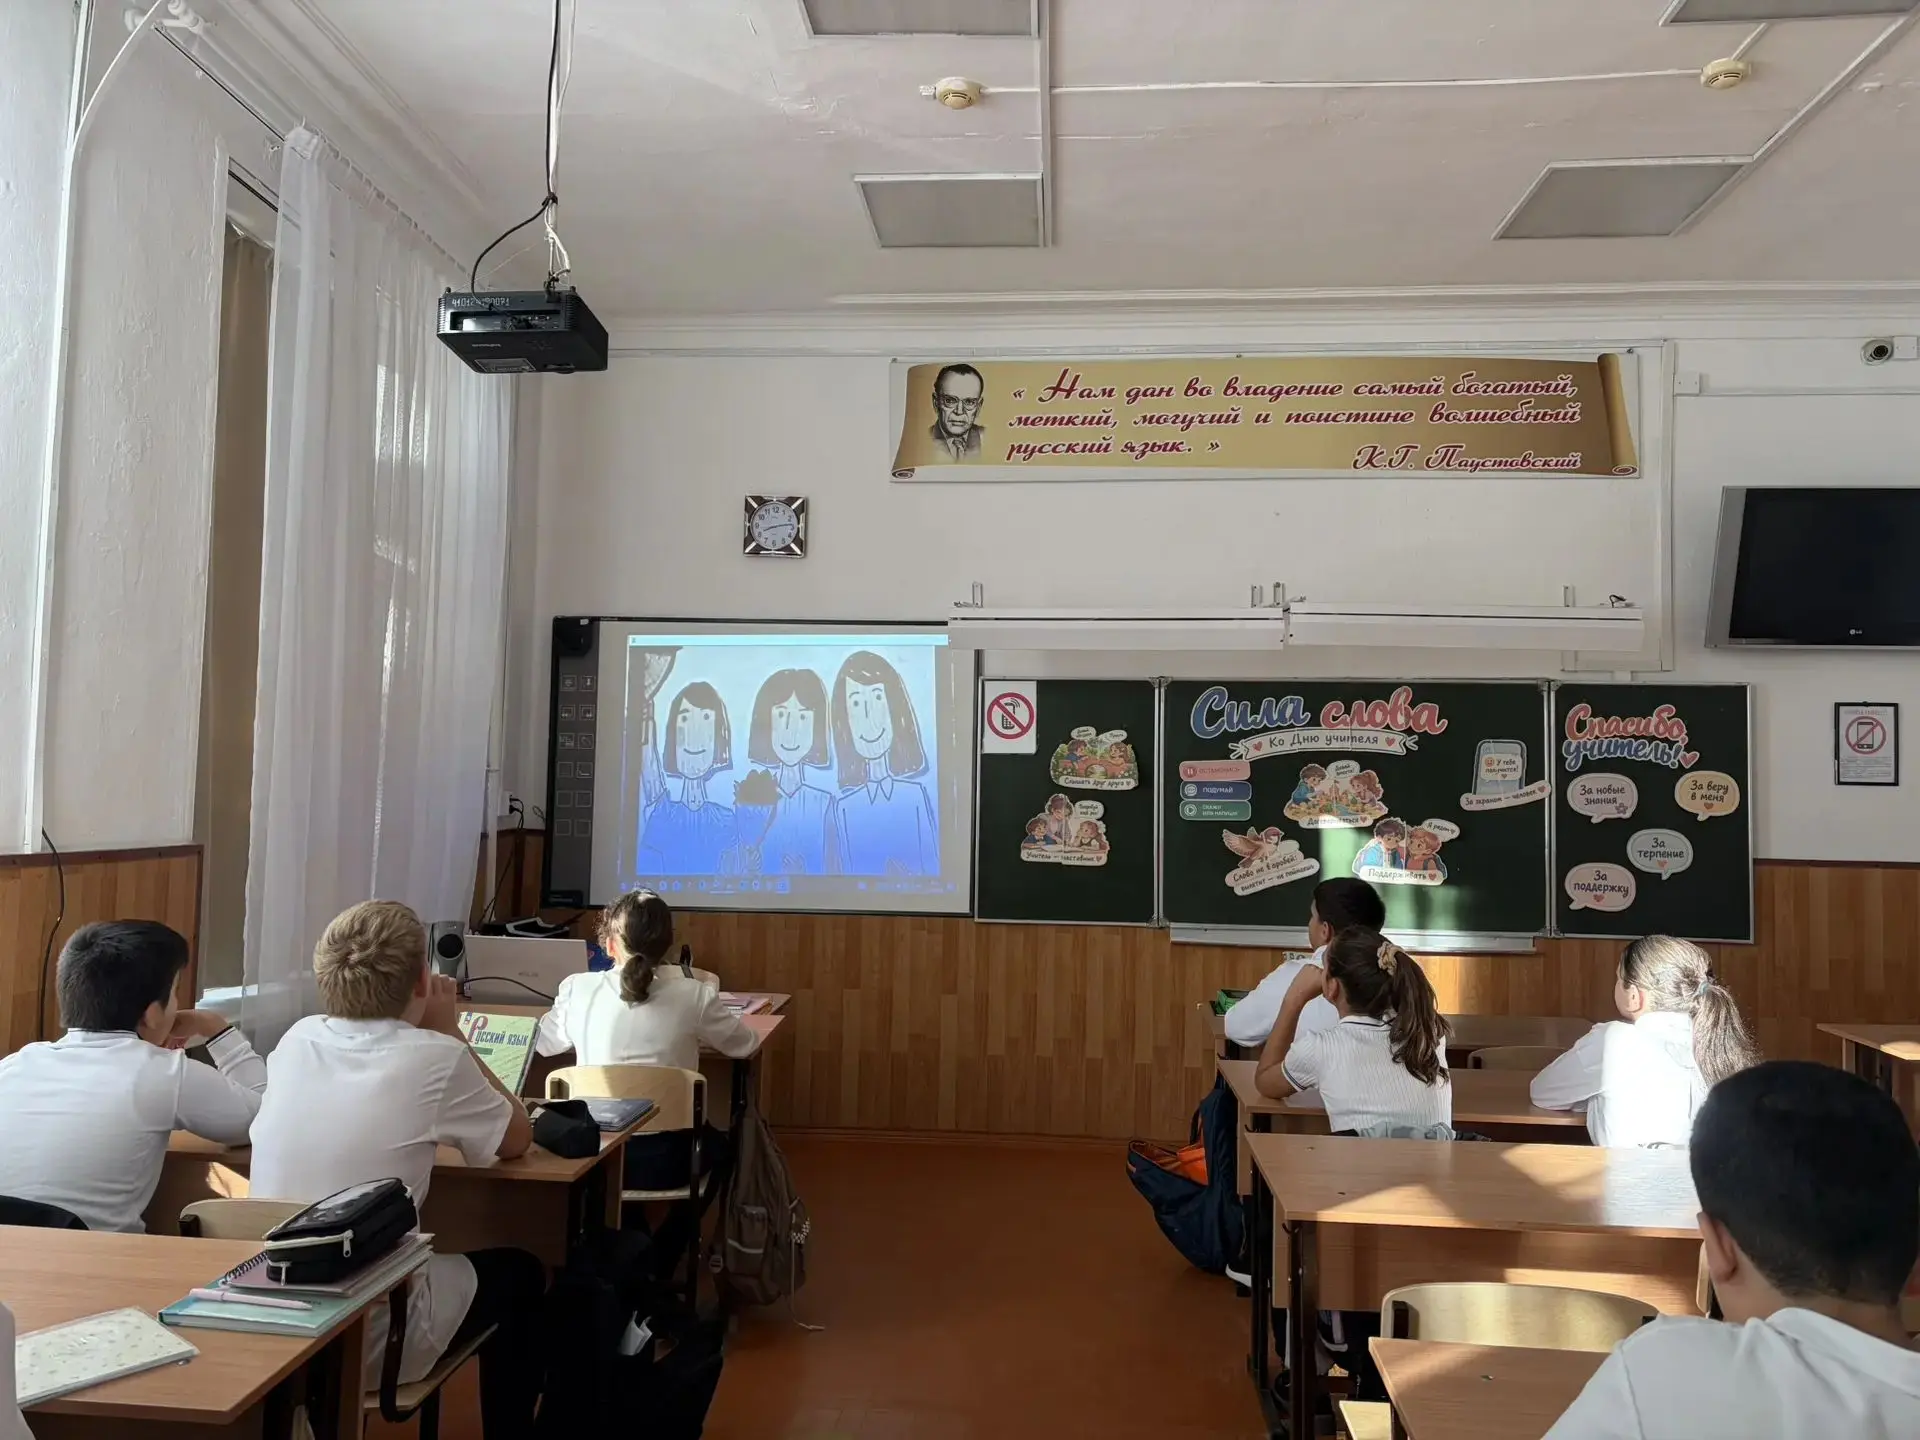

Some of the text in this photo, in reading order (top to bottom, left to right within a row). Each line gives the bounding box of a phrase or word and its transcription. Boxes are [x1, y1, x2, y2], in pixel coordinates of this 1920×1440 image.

[1038, 367, 1116, 403] Нам
[1125, 385, 1174, 405] дан
[1183, 376, 1212, 397] во
[1222, 376, 1343, 403] владение
[1353, 376, 1444, 396] самый
[1452, 371, 1578, 397] богатый,
[1008, 400, 1580, 432] меткий, могучий и поистине волшебный
[1006, 436, 1113, 461] русский
[1120, 441, 1192, 460] язык.
[1352, 444, 1581, 474] К.Г. Паустовский
[1191, 685, 1448, 739] Сила слова
[1565, 703, 1688, 745] Спасибо,
[1269, 734, 1379, 748] Ко Дню учителя
[1563, 737, 1684, 771] учитель!
[1580, 784, 1626, 795] За новые
[1690, 780, 1729, 794] За веру
[1584, 796, 1618, 806] знания
[1691, 792, 1725, 803] в меня
[1652, 837, 1665, 848] За
[1638, 849, 1684, 859] терпение
[1594, 870, 1607, 881] За
[1574, 883, 1629, 898] поддержку
[467, 1015, 529, 1047] Русский язык
